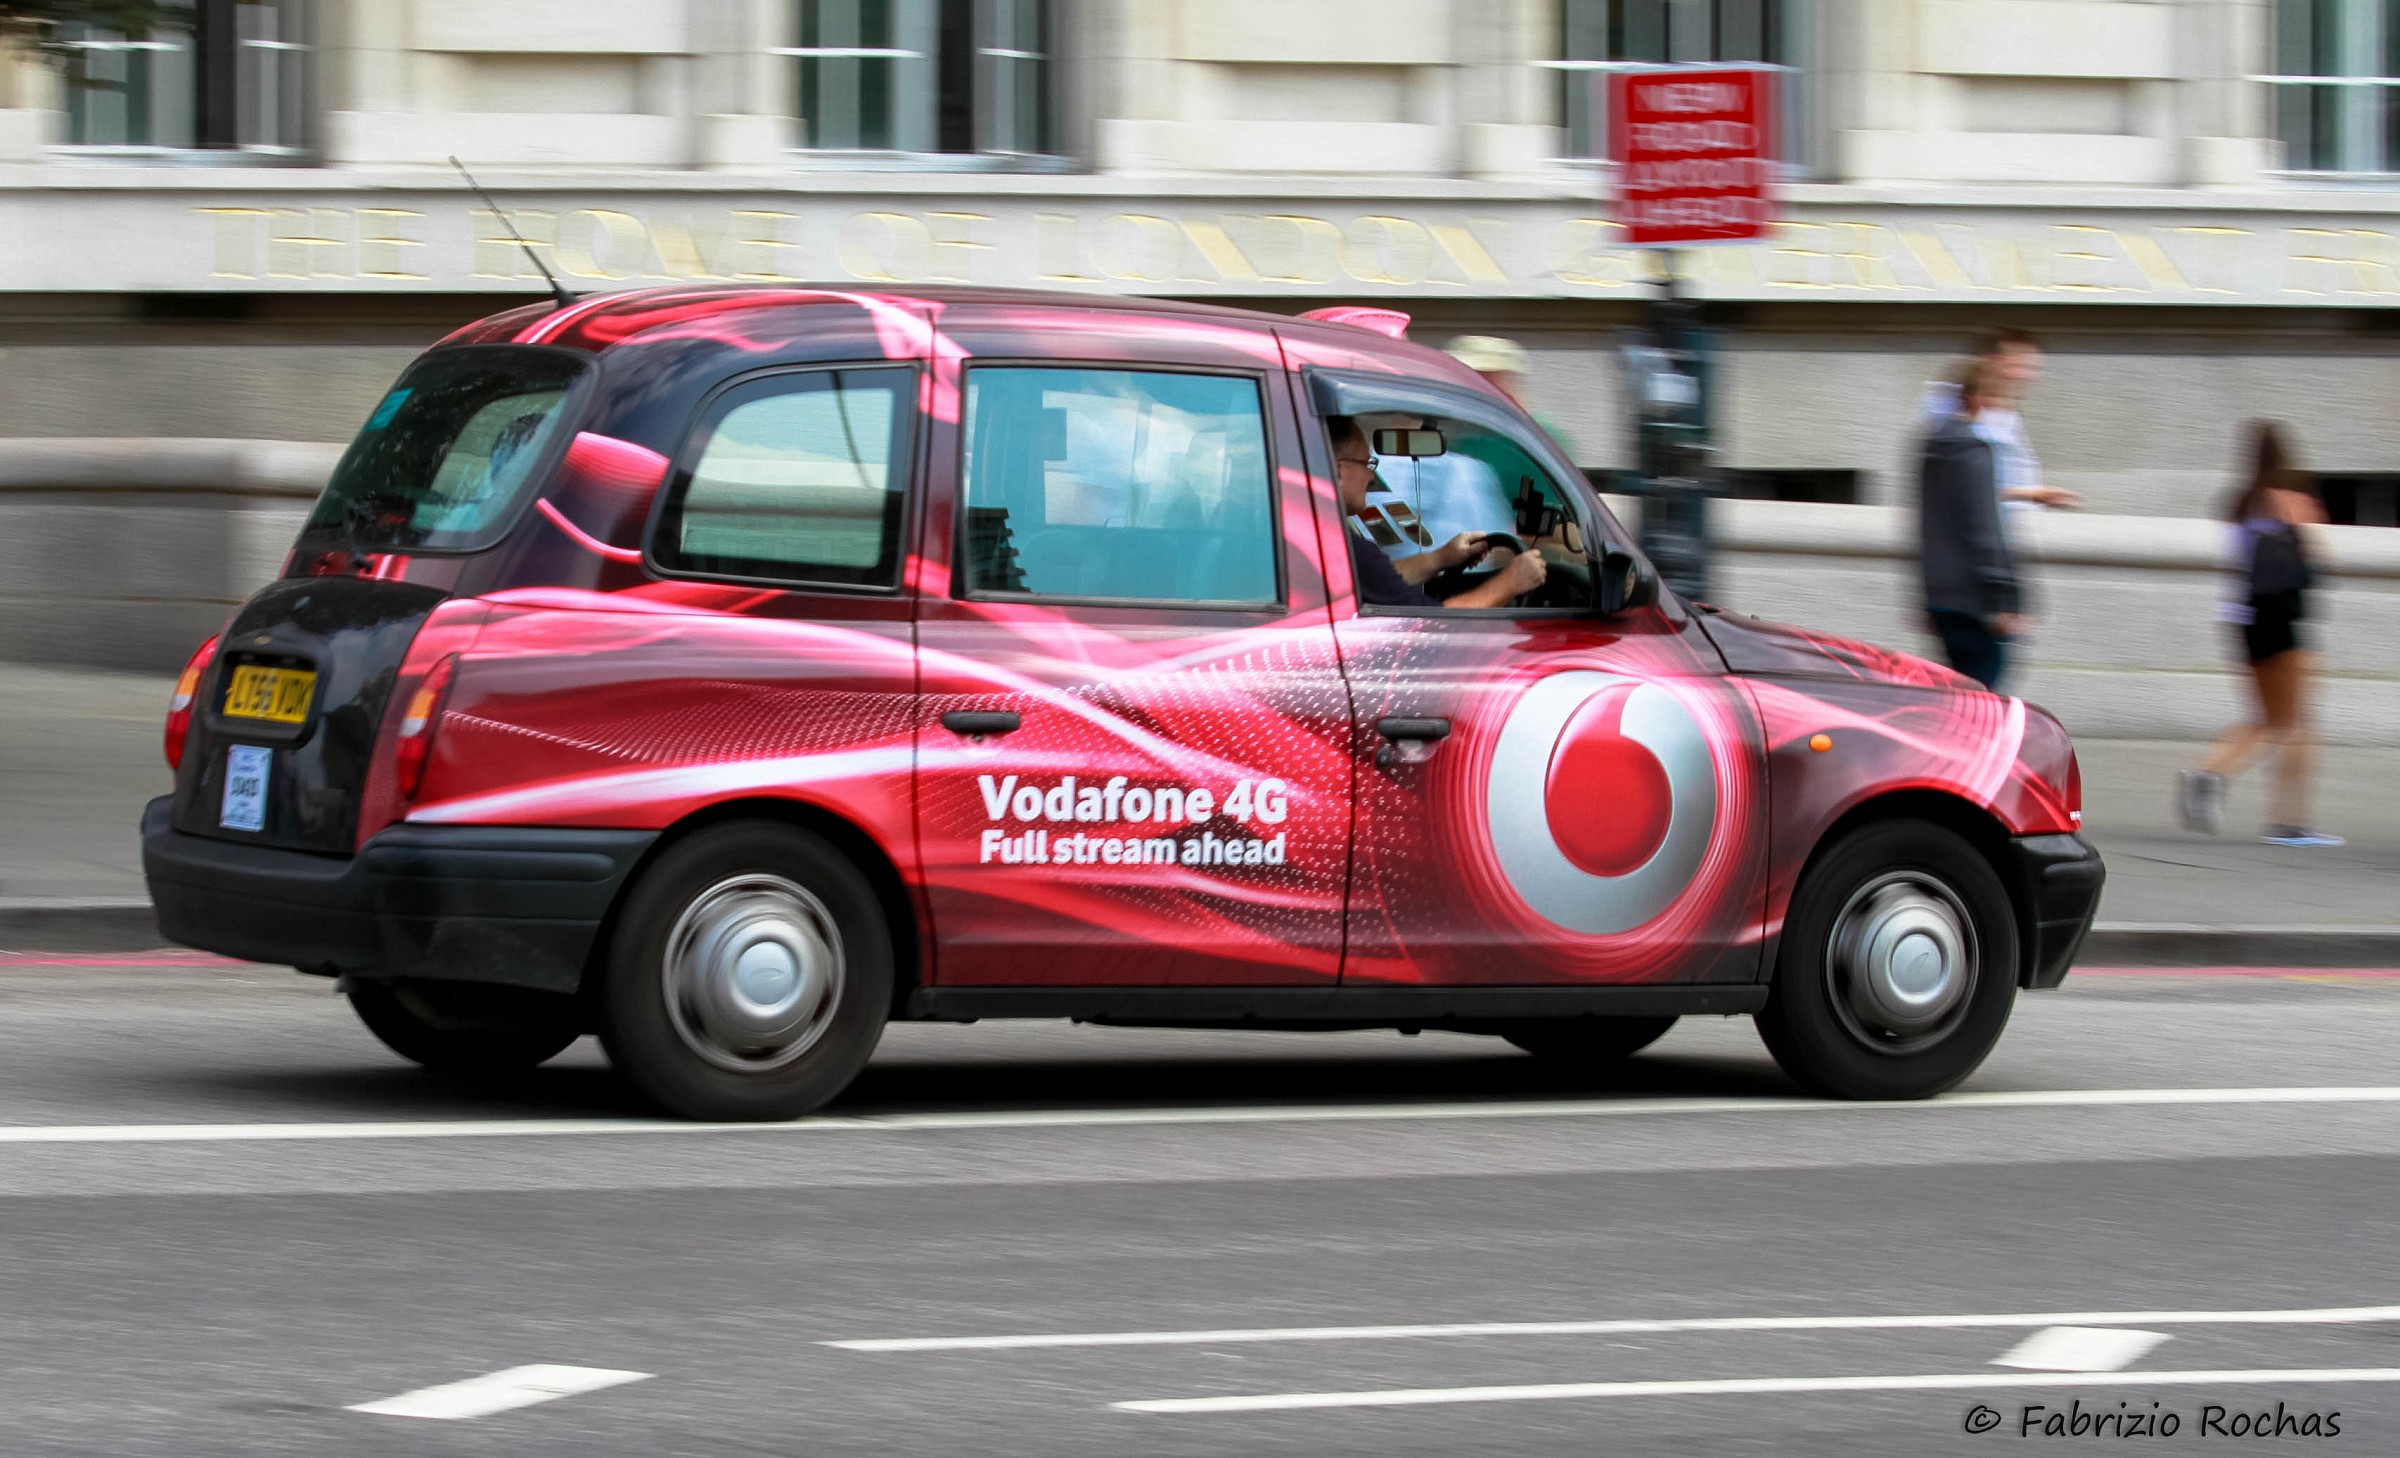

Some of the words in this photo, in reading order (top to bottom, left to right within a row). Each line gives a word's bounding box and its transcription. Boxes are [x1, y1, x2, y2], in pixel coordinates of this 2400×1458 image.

[190, 207, 429, 281] THE
[978, 774, 1215, 823] Vodafone
[1221, 777, 1288, 825] 4G
[979, 829, 1049, 865] Full
[1051, 832, 1178, 865] stream
[1180, 831, 1286, 866] ahead
